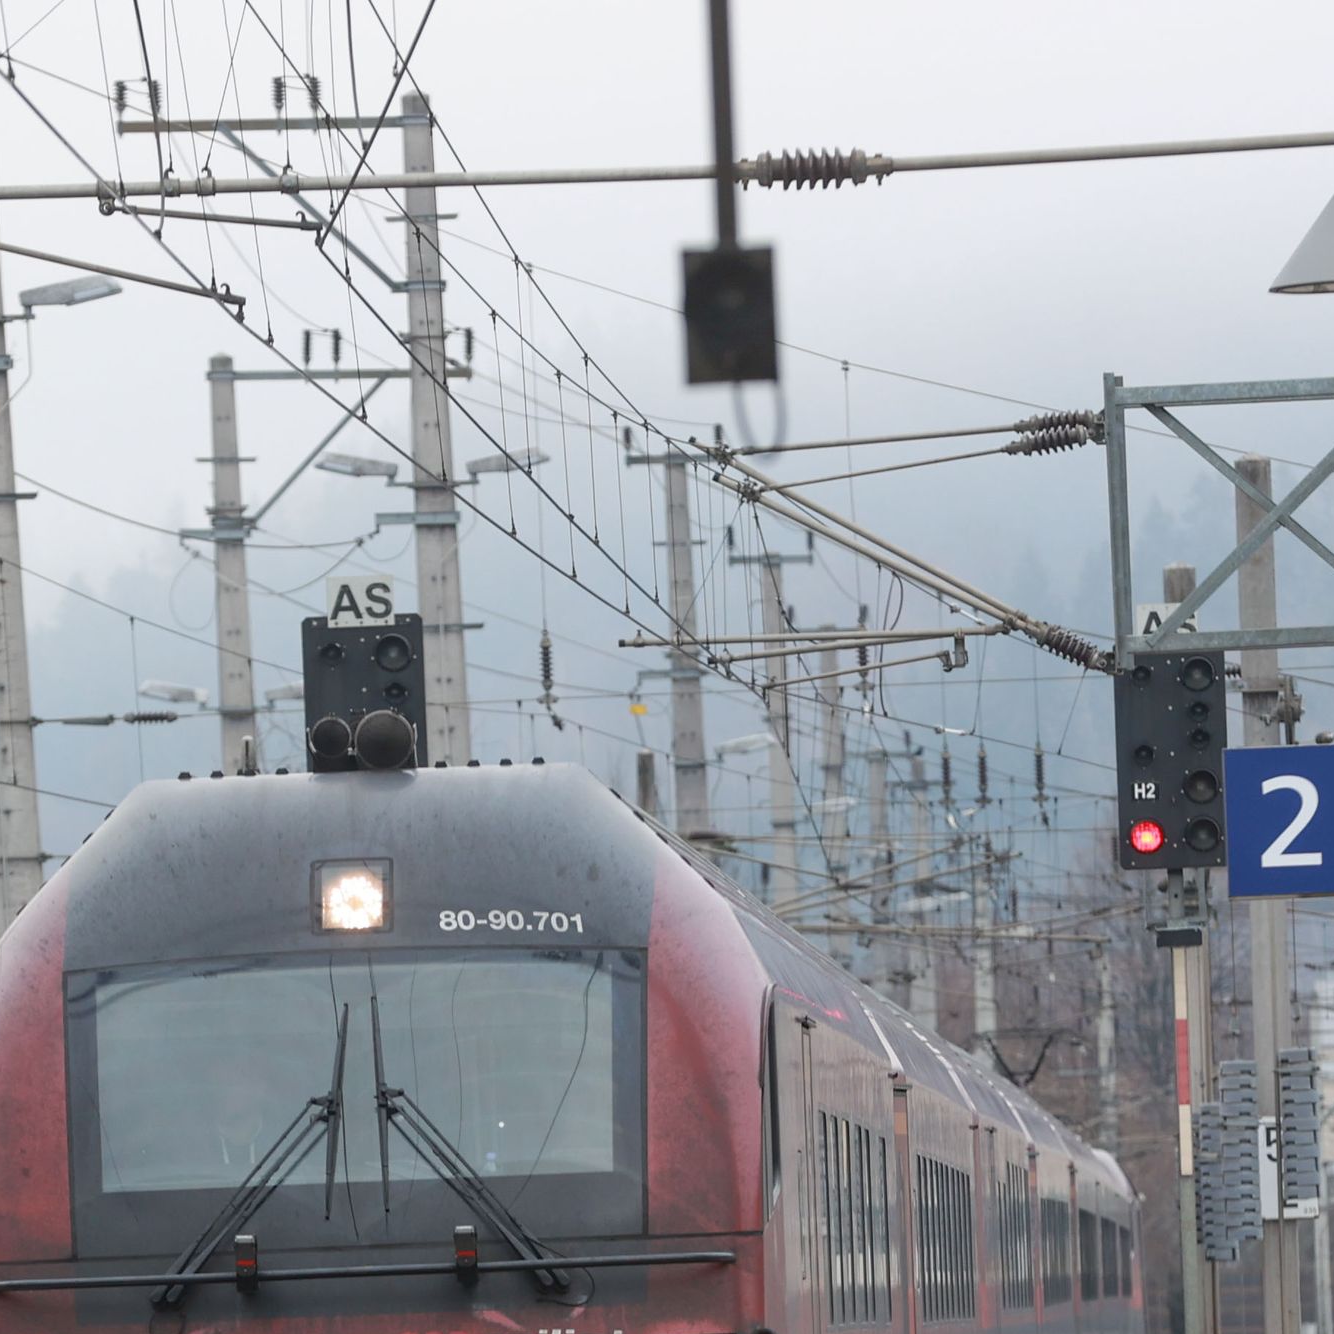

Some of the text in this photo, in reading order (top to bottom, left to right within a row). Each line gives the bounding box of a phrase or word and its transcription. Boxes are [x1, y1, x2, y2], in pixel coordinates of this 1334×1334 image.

[329, 581, 394, 621] AS
[1133, 782, 1157, 800] H2
[1260, 774, 1324, 868] 2
[439, 909, 584, 933] 80-90.701
